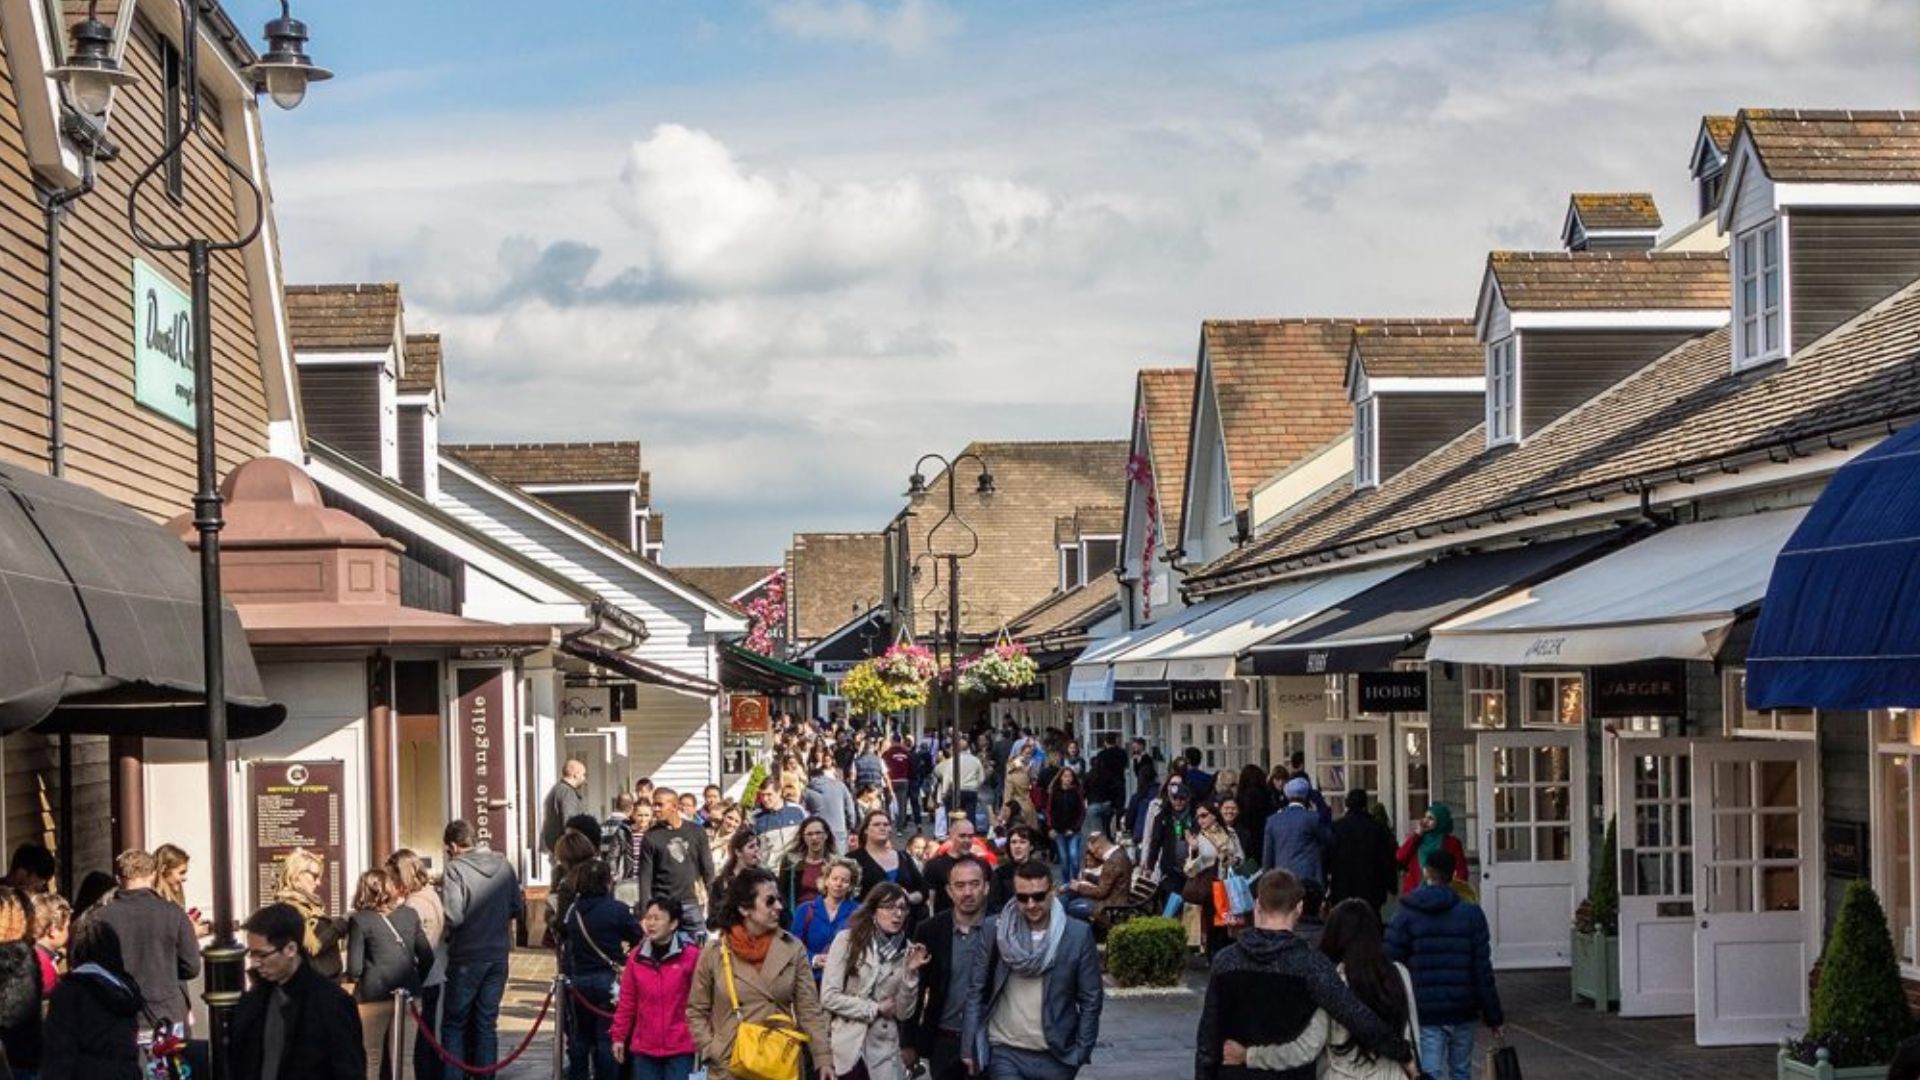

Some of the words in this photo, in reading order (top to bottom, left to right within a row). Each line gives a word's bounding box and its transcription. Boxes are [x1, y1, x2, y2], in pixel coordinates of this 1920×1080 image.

[1174, 688, 1217, 701] GINA
[1365, 686, 1421, 699] HOBBS
[1601, 681, 1675, 696] JAEGER
[472, 695, 490, 775] angélie
